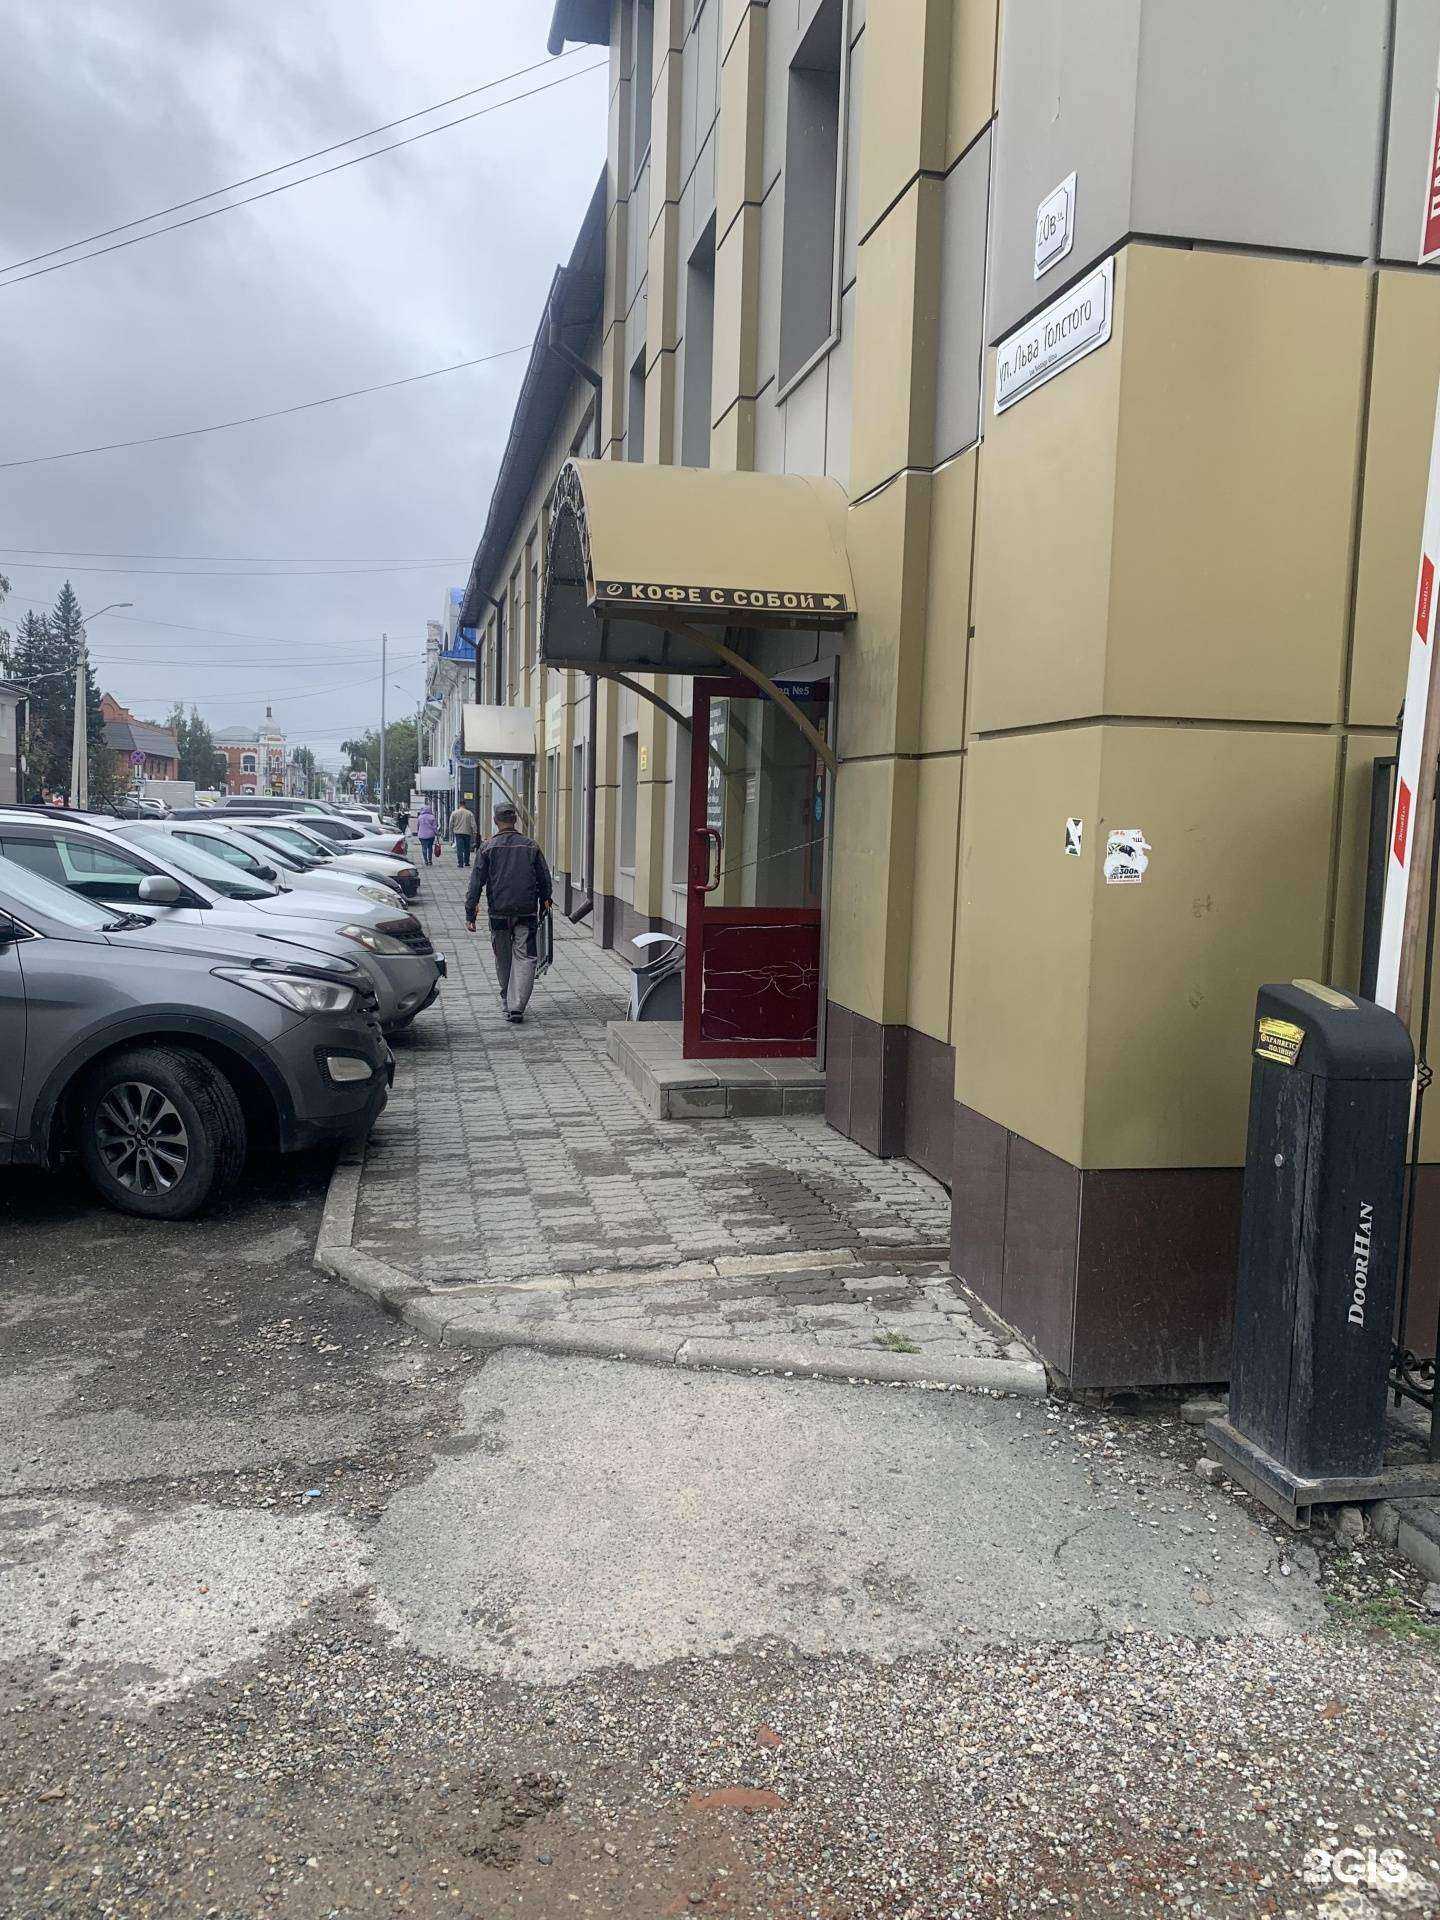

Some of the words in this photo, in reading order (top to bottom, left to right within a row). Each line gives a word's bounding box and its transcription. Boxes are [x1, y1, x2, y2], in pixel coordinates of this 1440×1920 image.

[1014, 339, 1039, 374] Льва
[1042, 299, 1092, 351] Толстого
[631, 584, 701, 602] КОФЕ
[710, 589, 725, 603] С
[733, 591, 815, 608] СОБОЙ
